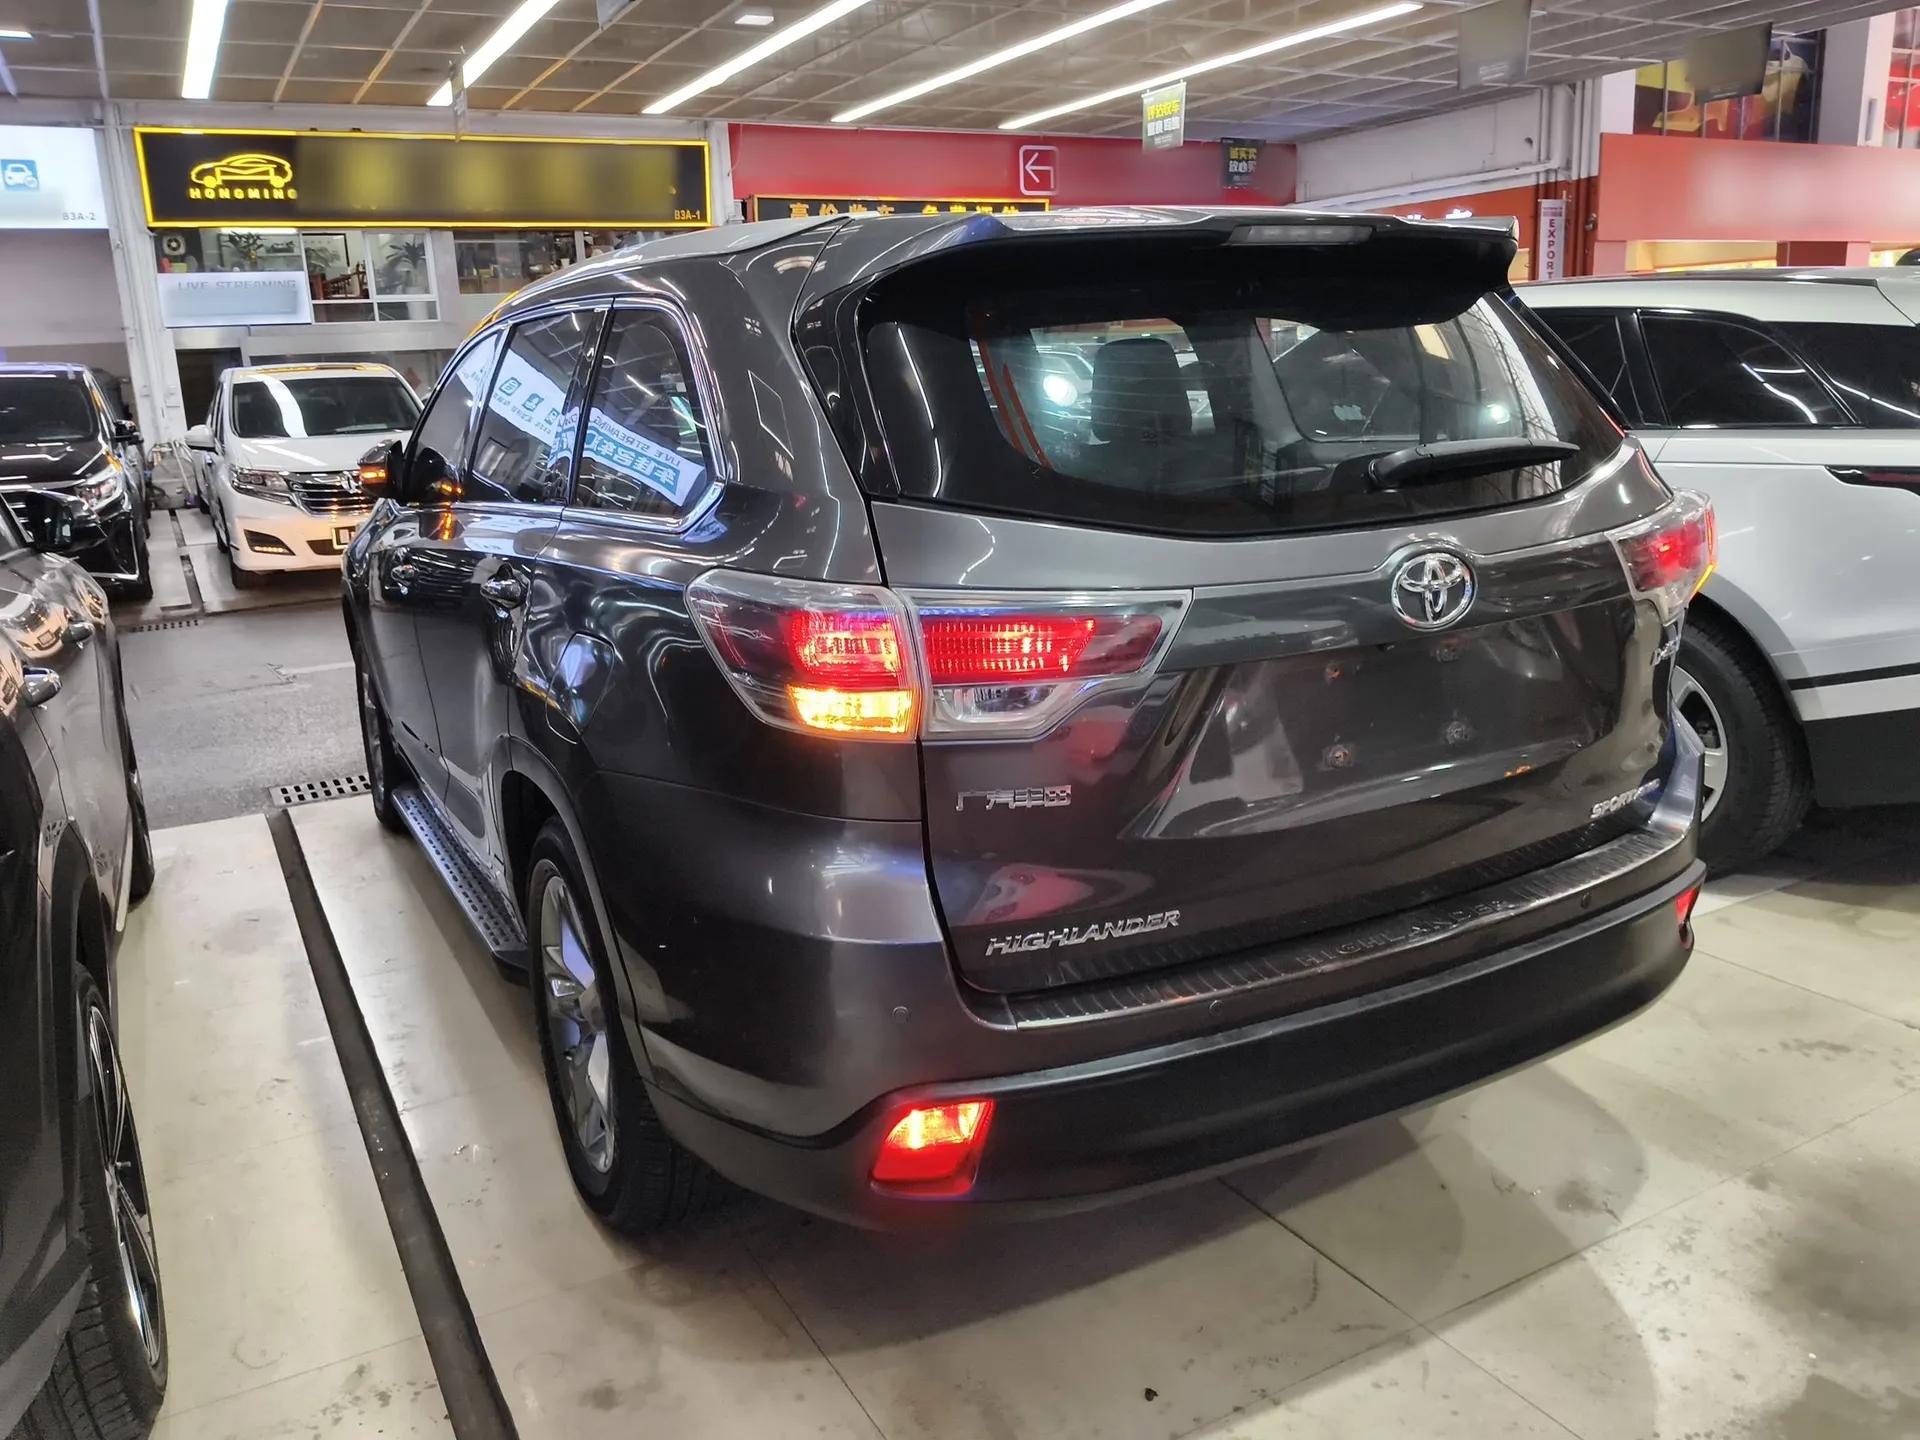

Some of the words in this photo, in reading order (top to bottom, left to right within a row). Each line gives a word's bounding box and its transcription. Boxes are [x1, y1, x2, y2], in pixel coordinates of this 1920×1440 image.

[674, 209, 701, 220] B3A-1
[178, 281, 209, 290] LIVE
[216, 279, 296, 289] STREAMING
[985, 909, 1182, 956] HIGHLANDER
[1295, 899, 1517, 967] HIGHLANDER
